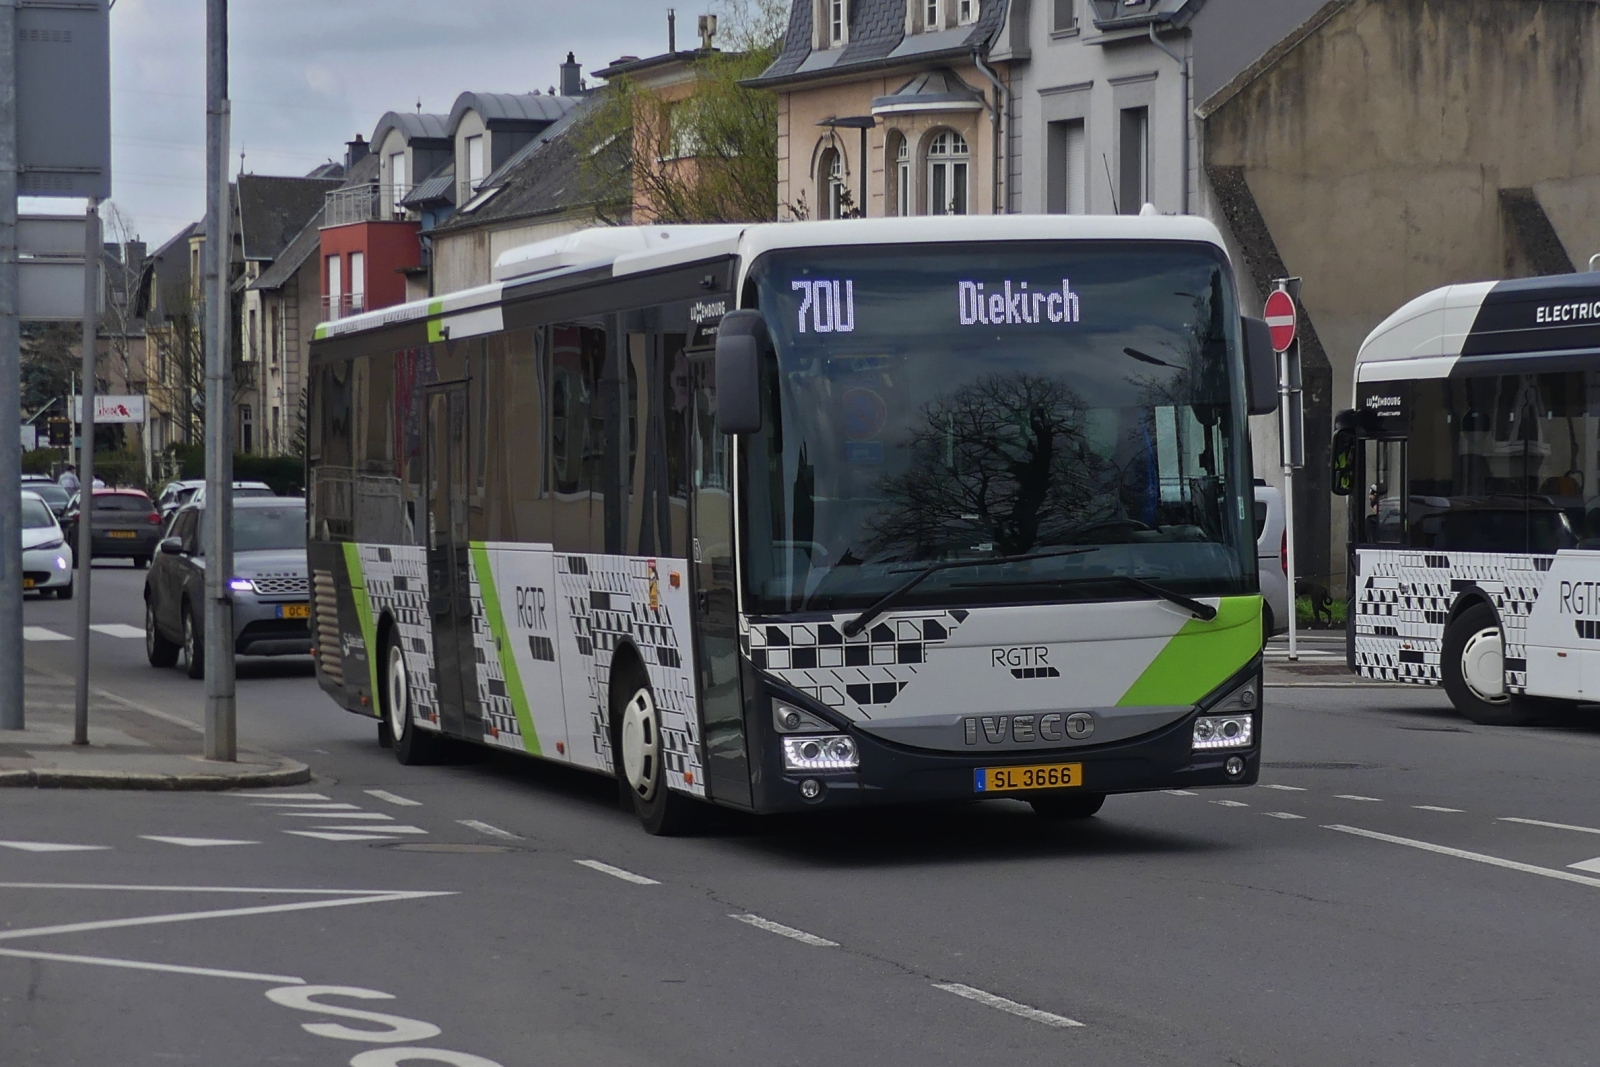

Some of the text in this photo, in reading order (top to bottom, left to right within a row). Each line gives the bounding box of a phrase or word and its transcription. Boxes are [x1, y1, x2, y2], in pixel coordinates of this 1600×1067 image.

[690, 301, 726, 324] LUXEMBOURG
[958, 278, 1081, 326] Diekirch
[1536, 301, 1600, 323] ELECTRIC
[516, 585, 548, 630] RGTR
[991, 646, 1049, 668] RGTR
[964, 711, 1096, 746] IVECO
[994, 770, 1018, 788] SL
[1023, 767, 1071, 787] 3666
